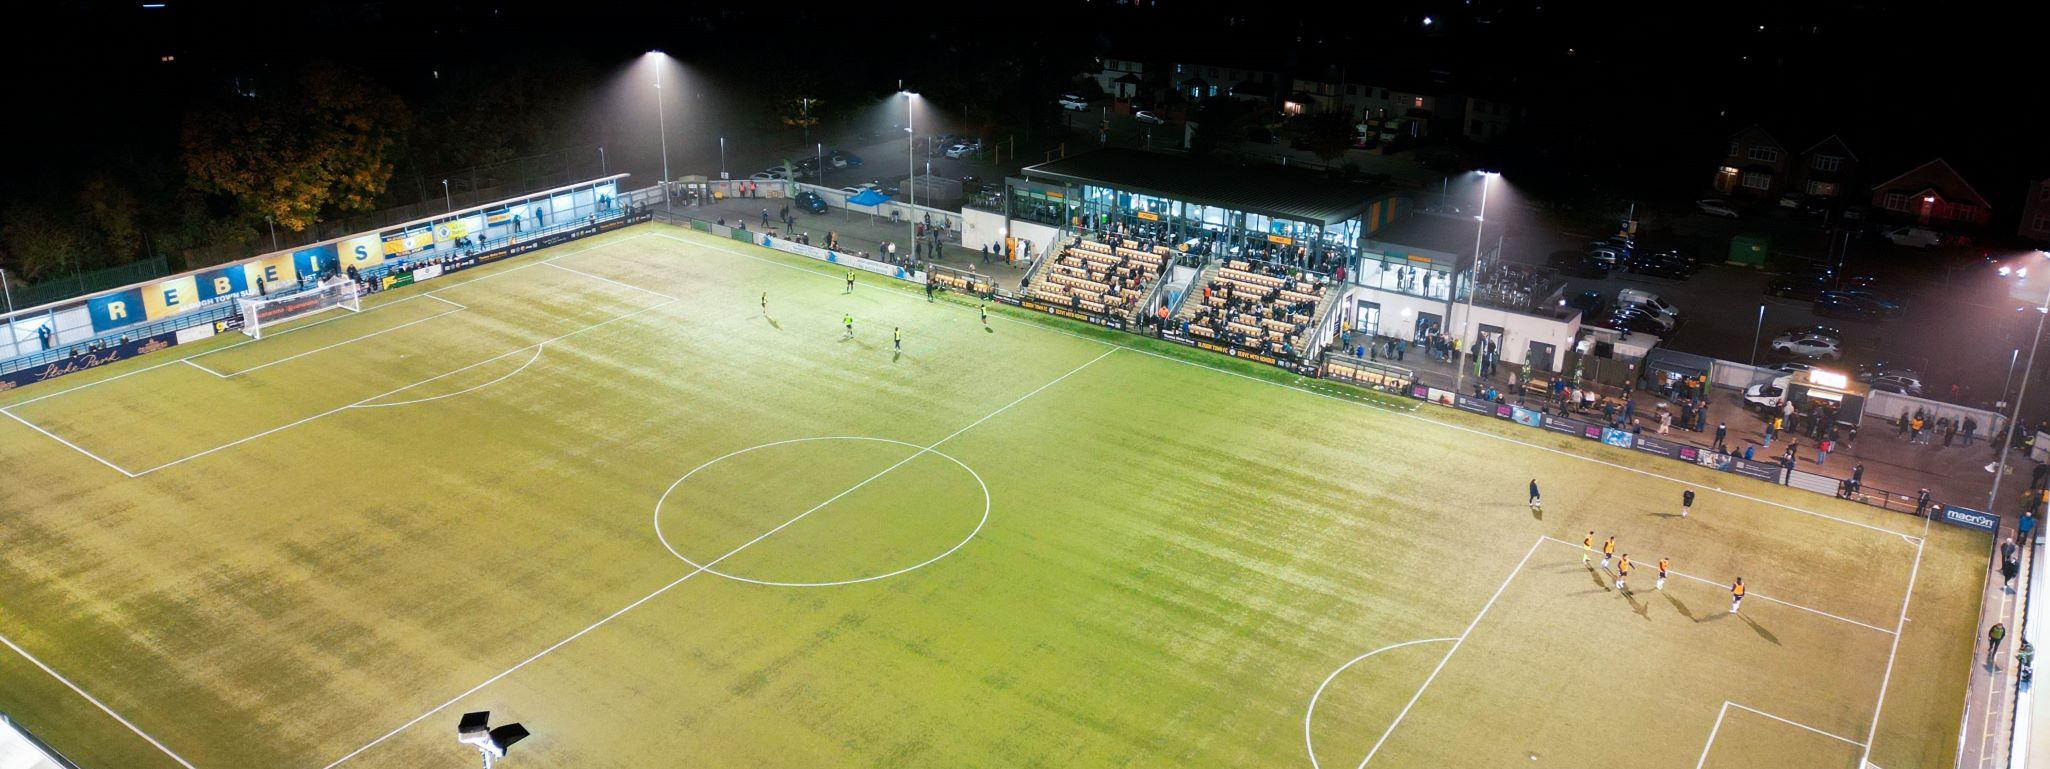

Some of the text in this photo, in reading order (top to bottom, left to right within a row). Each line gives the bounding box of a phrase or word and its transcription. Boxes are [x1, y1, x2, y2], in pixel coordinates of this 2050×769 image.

[214, 293, 240, 303] TOWN
[35, 350, 120, 381] Stoke Park
[1947, 510, 1996, 527] macron
